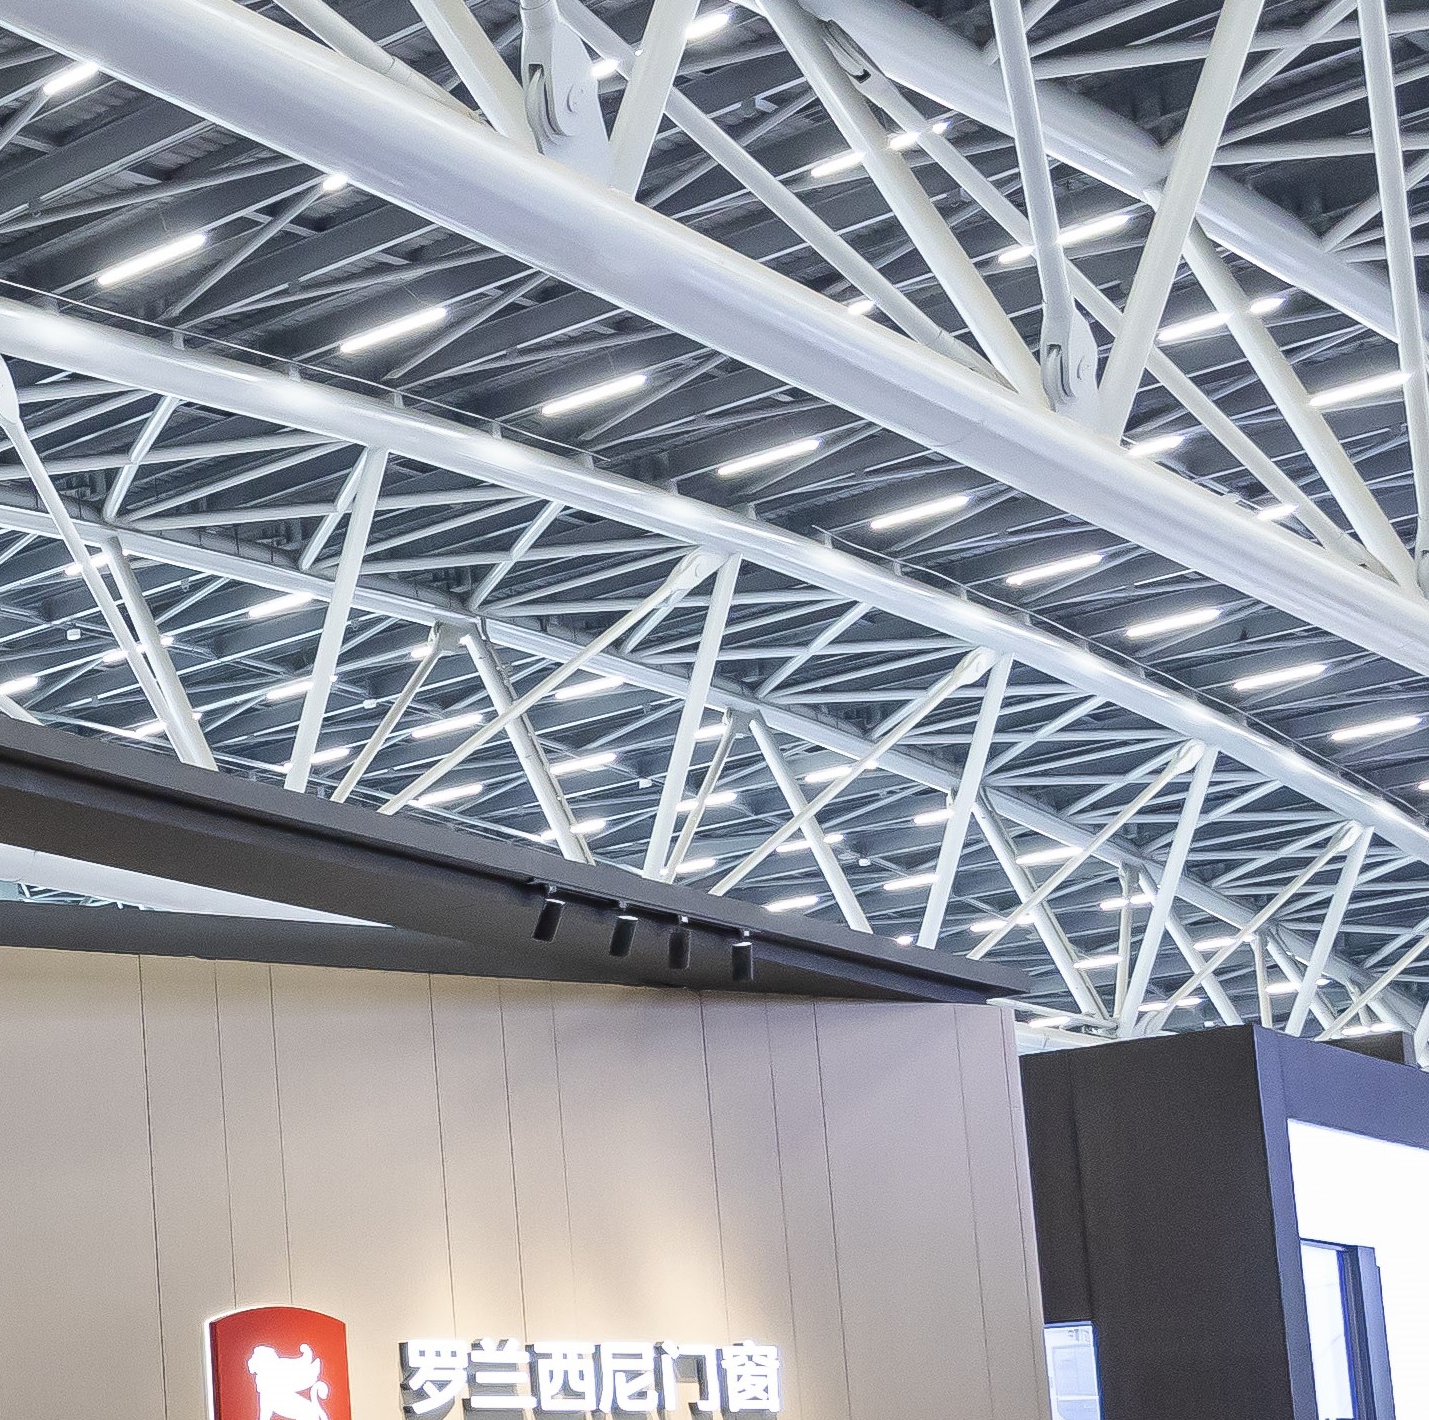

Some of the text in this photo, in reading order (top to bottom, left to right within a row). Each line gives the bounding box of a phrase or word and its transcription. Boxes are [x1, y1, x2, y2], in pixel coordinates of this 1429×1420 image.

[403, 1338, 783, 1414] 罗兰西尼门窗
